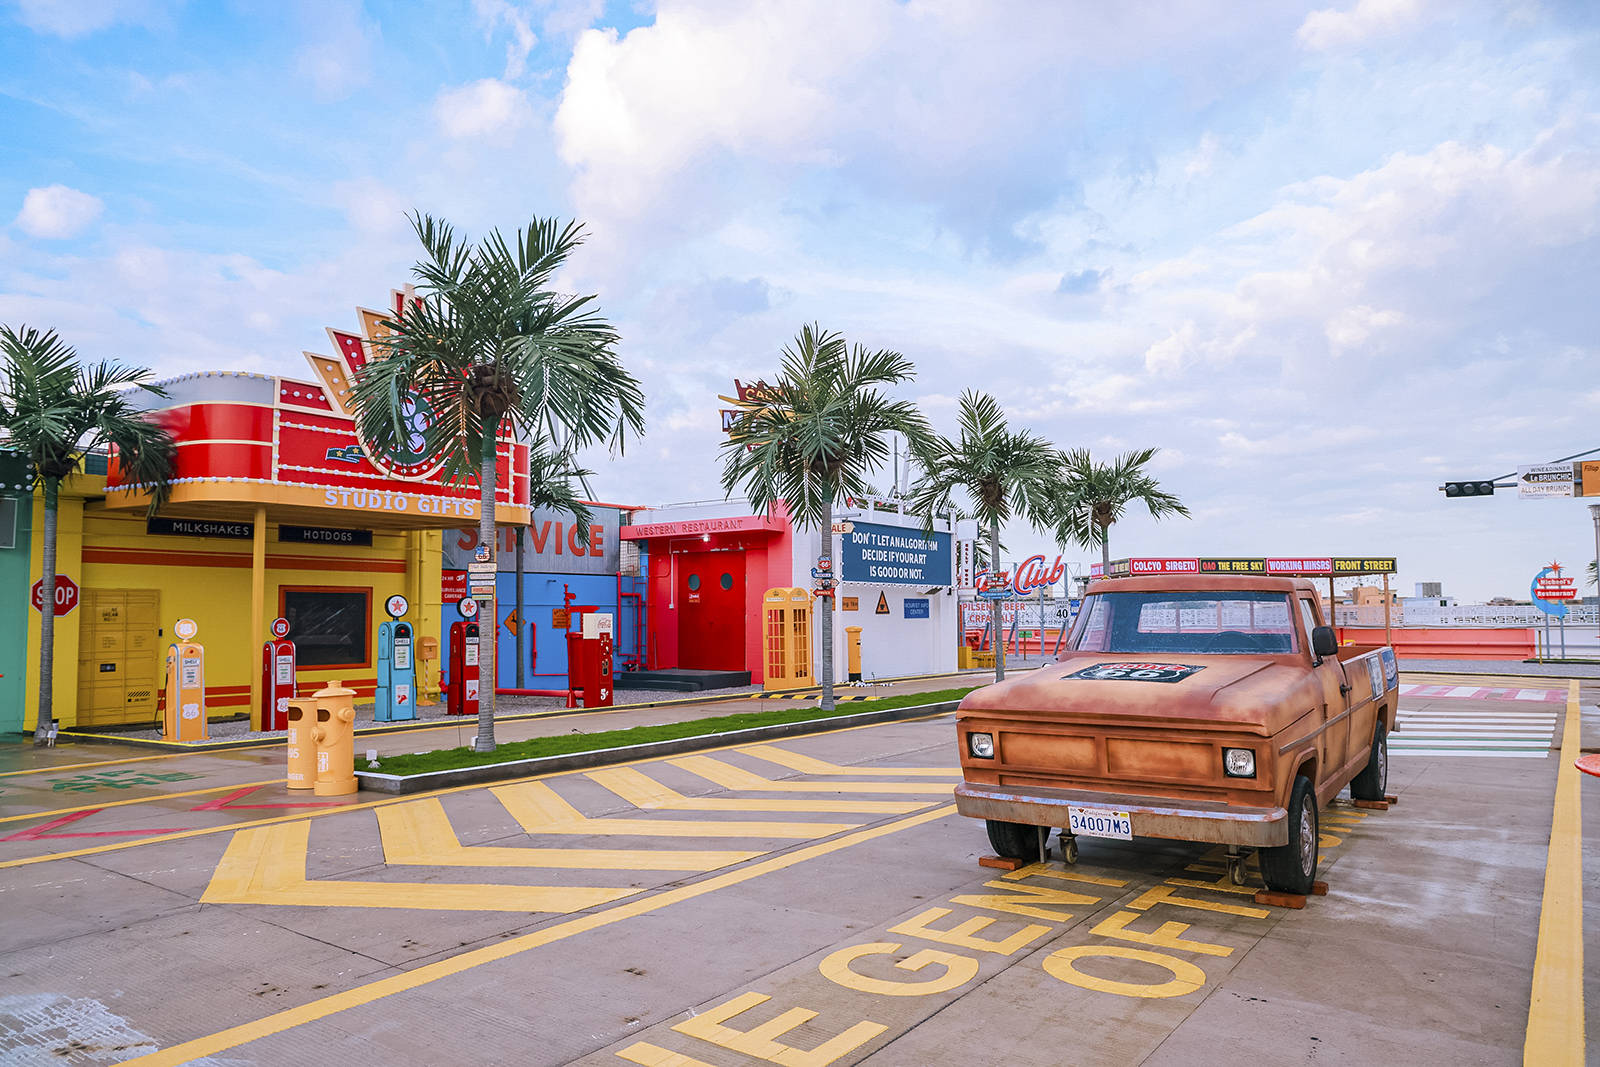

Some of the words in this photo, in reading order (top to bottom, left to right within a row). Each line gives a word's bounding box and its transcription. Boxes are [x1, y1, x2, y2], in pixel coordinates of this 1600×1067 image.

[325, 489, 408, 512] STUDIO
[417, 497, 475, 516] GIFTS
[172, 521, 249, 536] MILKSHAKES
[635, 524, 677, 537] WESTERN
[681, 519, 743, 533] RESTAURANT
[303, 529, 353, 542] HOTDOGS
[862, 549, 888, 561] DECIDE
[1218, 562, 1231, 571] THE
[1232, 562, 1249, 571] FREE
[1250, 562, 1264, 571] SKY
[1268, 561, 1302, 571] WORKING
[1335, 560, 1362, 571] FRONT
[1363, 560, 1393, 571] STREET
[870, 566, 877, 577] IS
[877, 567, 898, 578] GOOD
[898, 568, 909, 579] OR
[1013, 554, 1065, 595] Club
[36, 586, 74, 605] SOP
[1004, 602, 1025, 611] BEER
[1056, 608, 1068, 619] 40
[1096, 669, 1164, 678] 66
[1071, 815, 1130, 835] 34007M3
